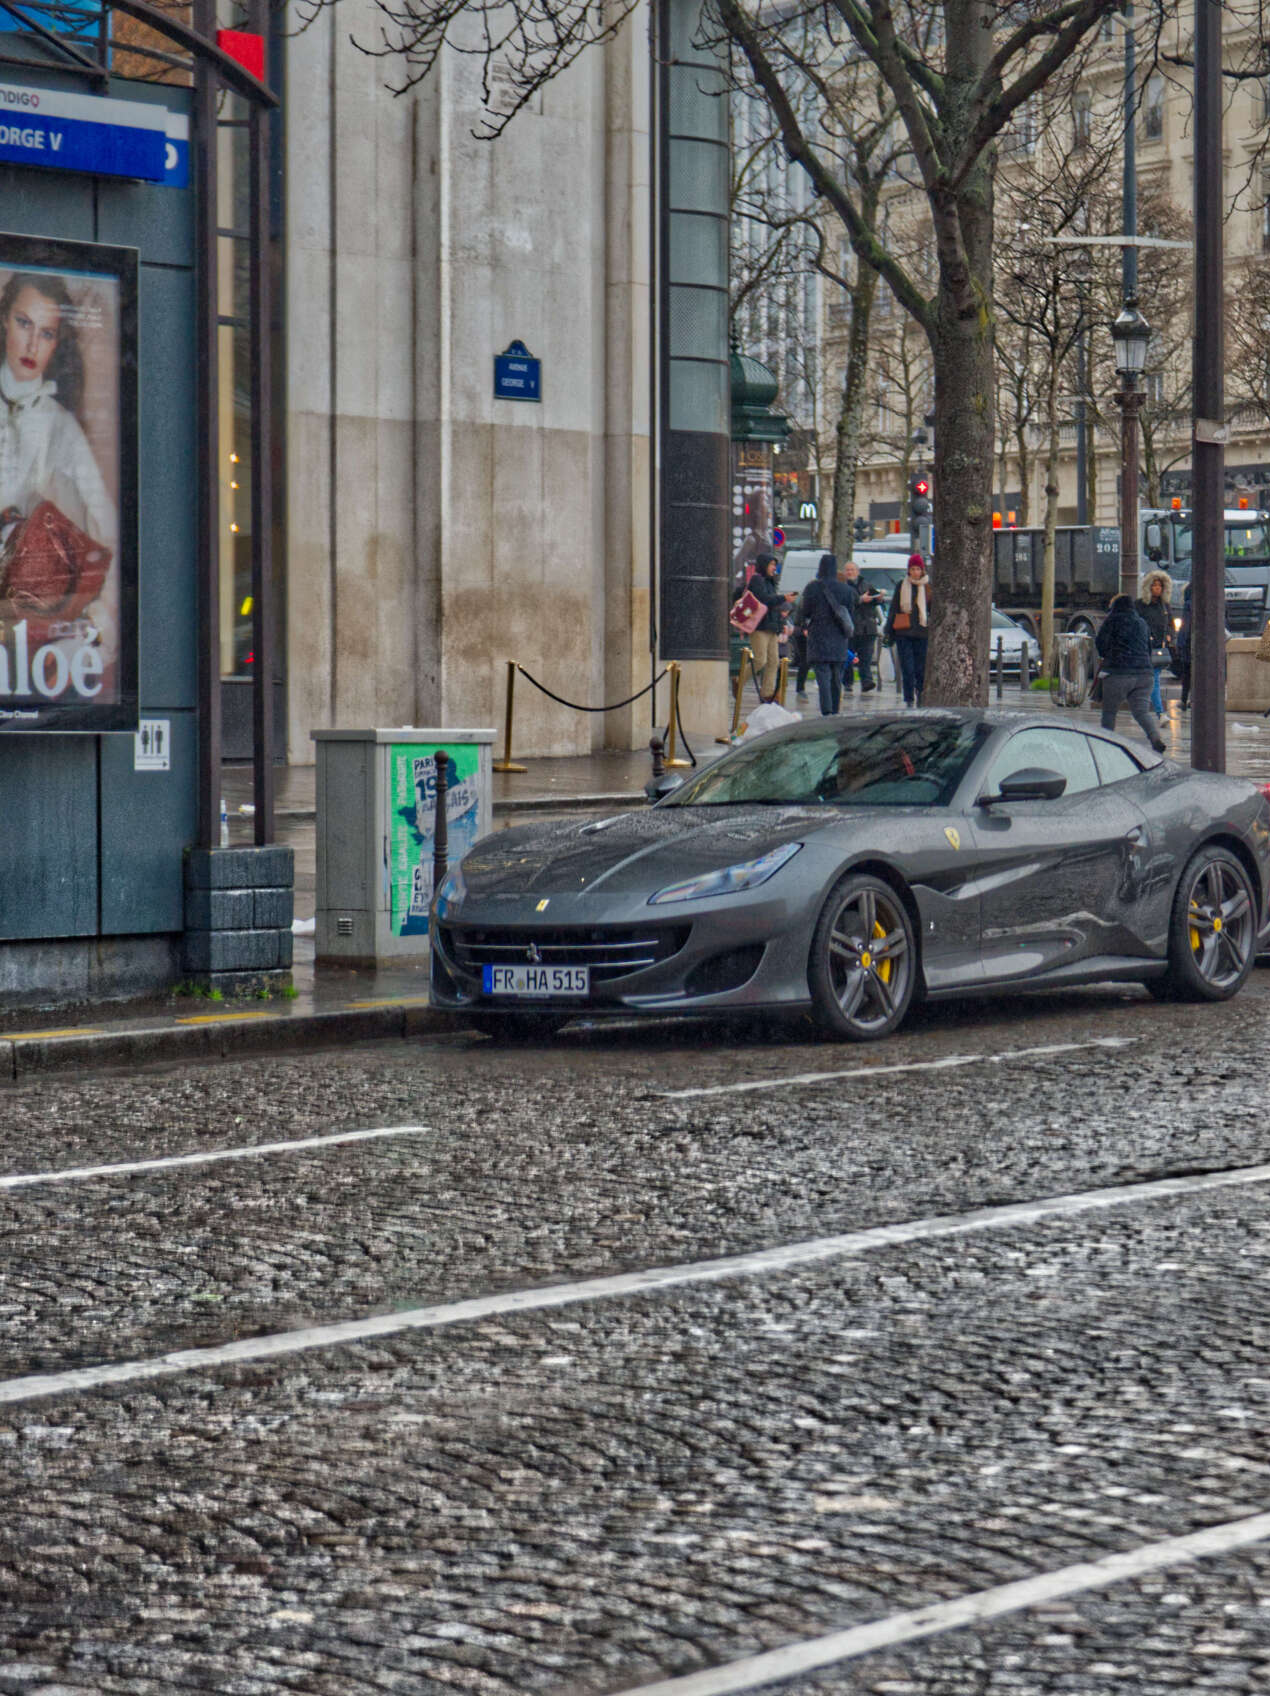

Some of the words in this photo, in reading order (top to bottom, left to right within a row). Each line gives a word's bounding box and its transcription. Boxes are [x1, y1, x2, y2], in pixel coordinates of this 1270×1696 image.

[50, 131, 63, 150] V
[414, 758, 435, 770] PARI
[493, 968, 515, 990] FR
[526, 968, 549, 990] HA
[552, 970, 586, 991] 515
